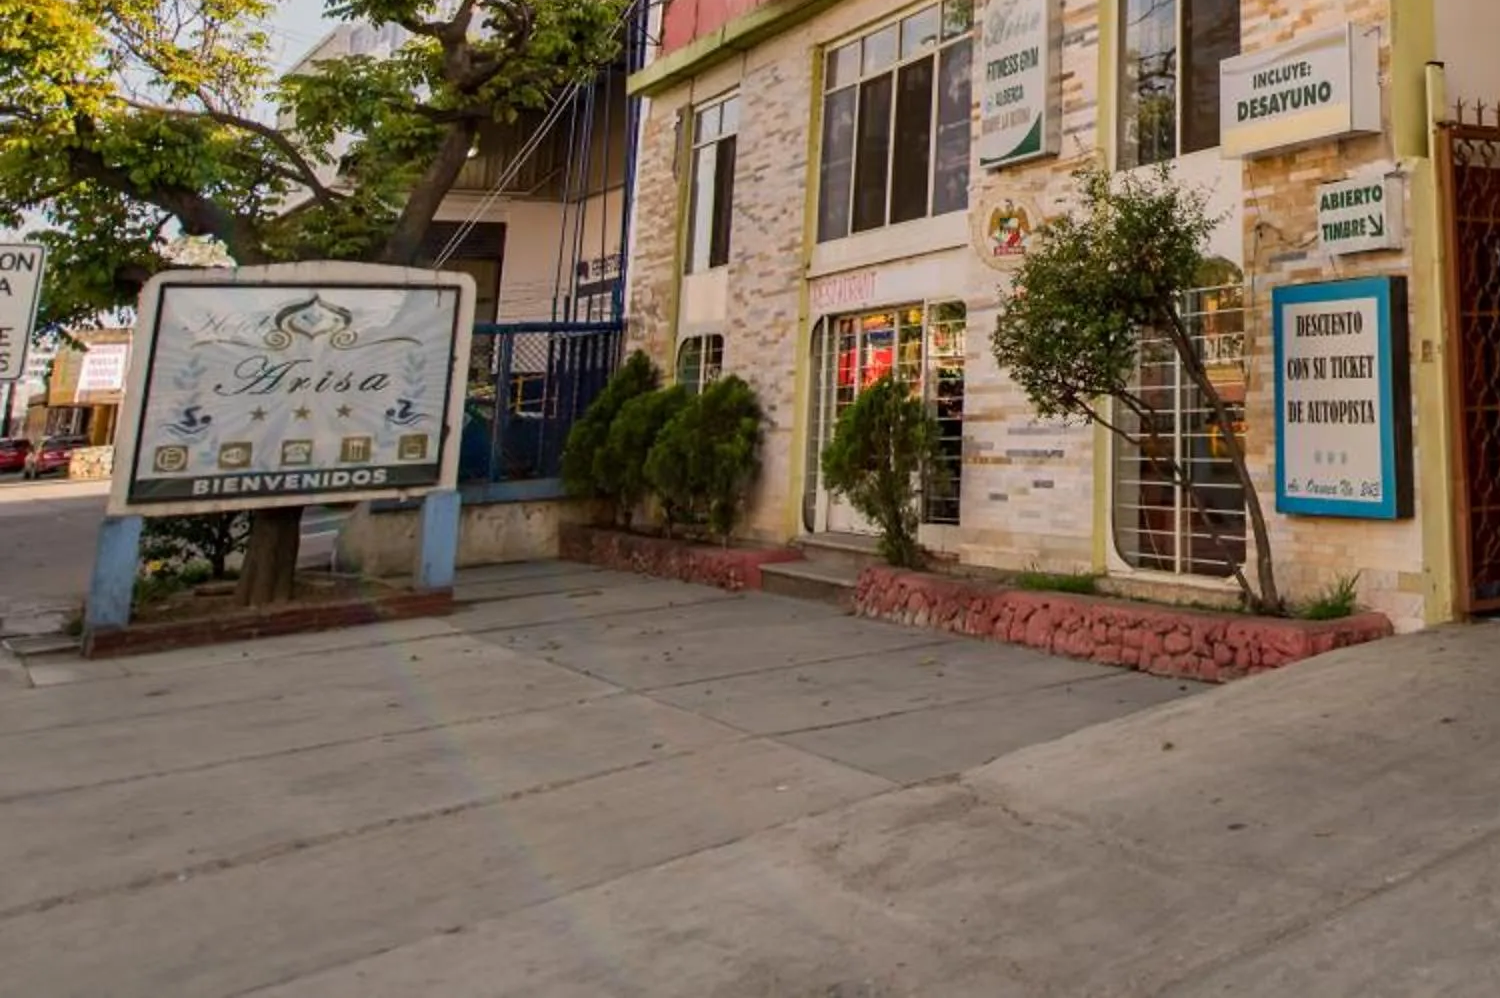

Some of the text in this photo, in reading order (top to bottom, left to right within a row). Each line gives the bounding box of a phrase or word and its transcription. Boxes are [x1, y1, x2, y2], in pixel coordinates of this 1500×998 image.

[1253, 61, 1311, 90] INCLUYE:
[1237, 81, 1332, 122] DESAYUNO
[1320, 185, 1382, 212] ABIERTO
[1322, 217, 1366, 242] TIMBRE
[1296, 311, 1363, 338] DESCUENTO
[213, 355, 391, 397] Arisa
[1287, 355, 1374, 380] CON SU TICKET
[1288, 399, 1375, 424] DE AUTOPISTA
[193, 468, 387, 496] BIENVENIDOS
